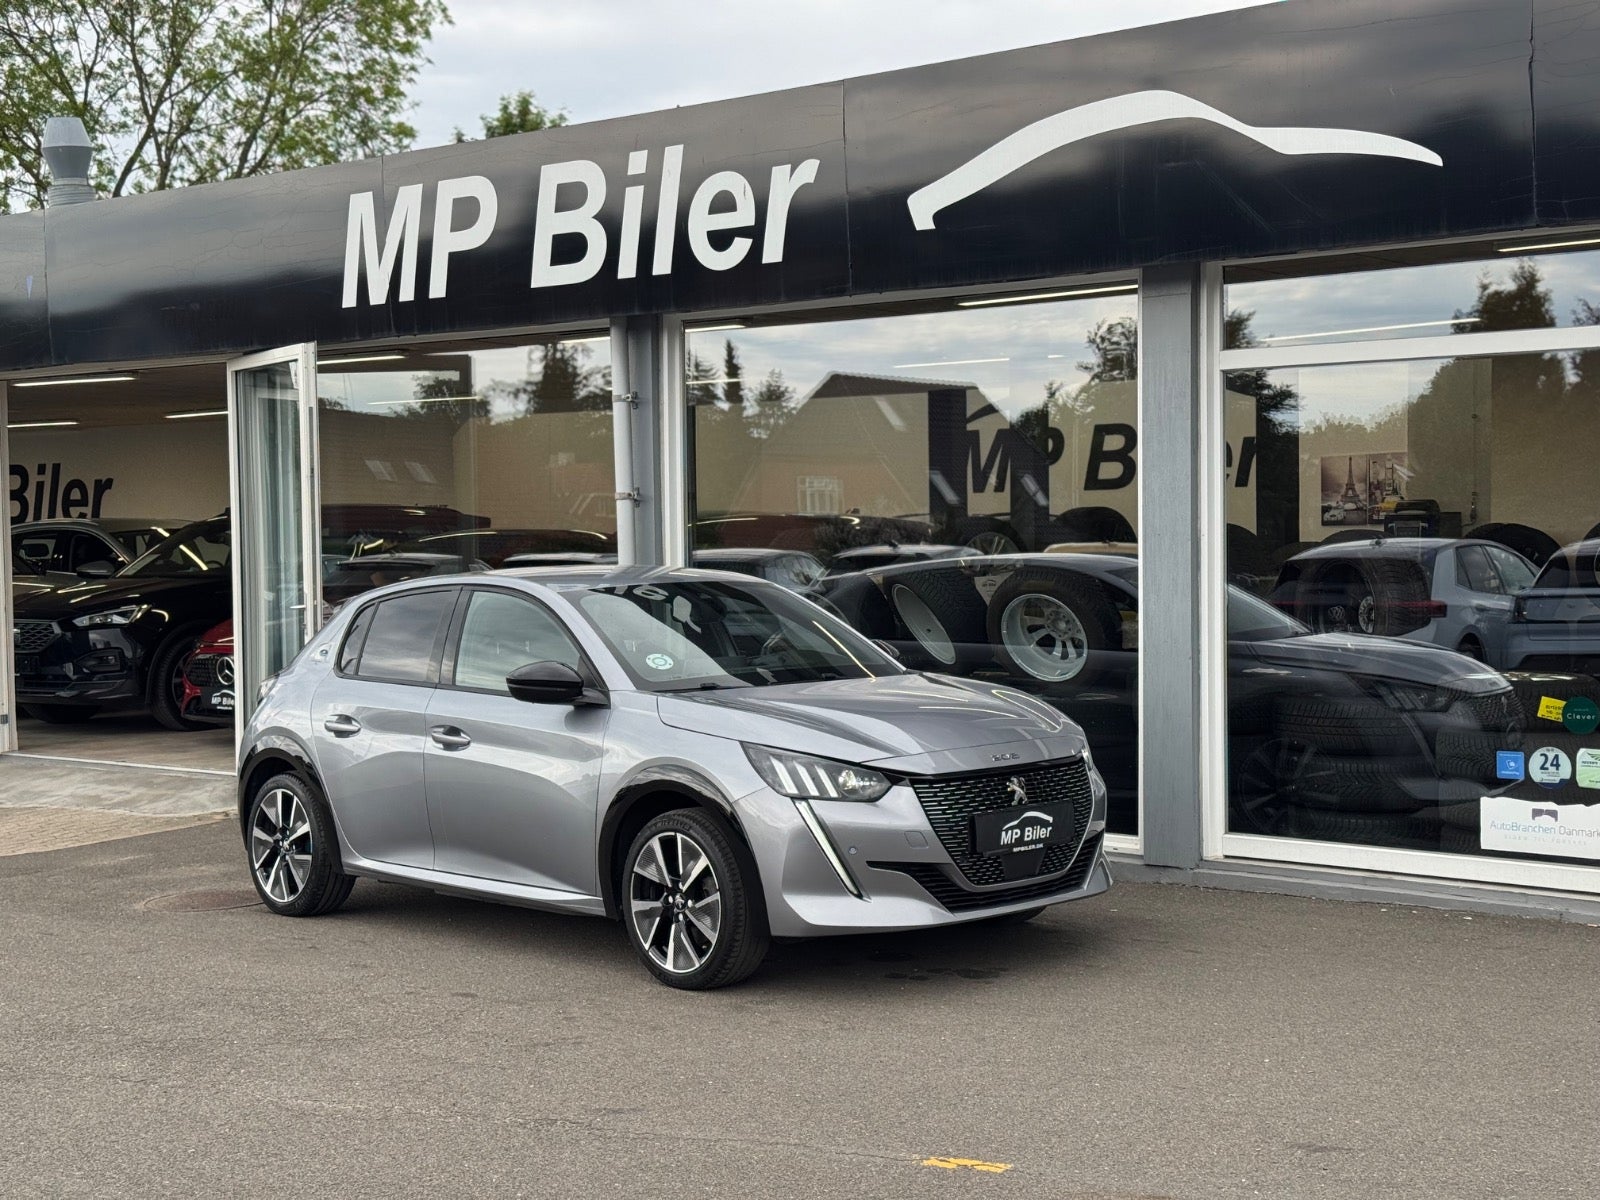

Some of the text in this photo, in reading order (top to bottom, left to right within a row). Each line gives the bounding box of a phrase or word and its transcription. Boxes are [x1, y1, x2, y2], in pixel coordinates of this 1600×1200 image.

[342, 144, 820, 309] MP Biler
[9, 463, 114, 525] Biler
[1539, 753, 1561, 771] 24
[1000, 825, 1052, 845] MP Biler
[1490, 821, 1556, 834] AutoBranchen
